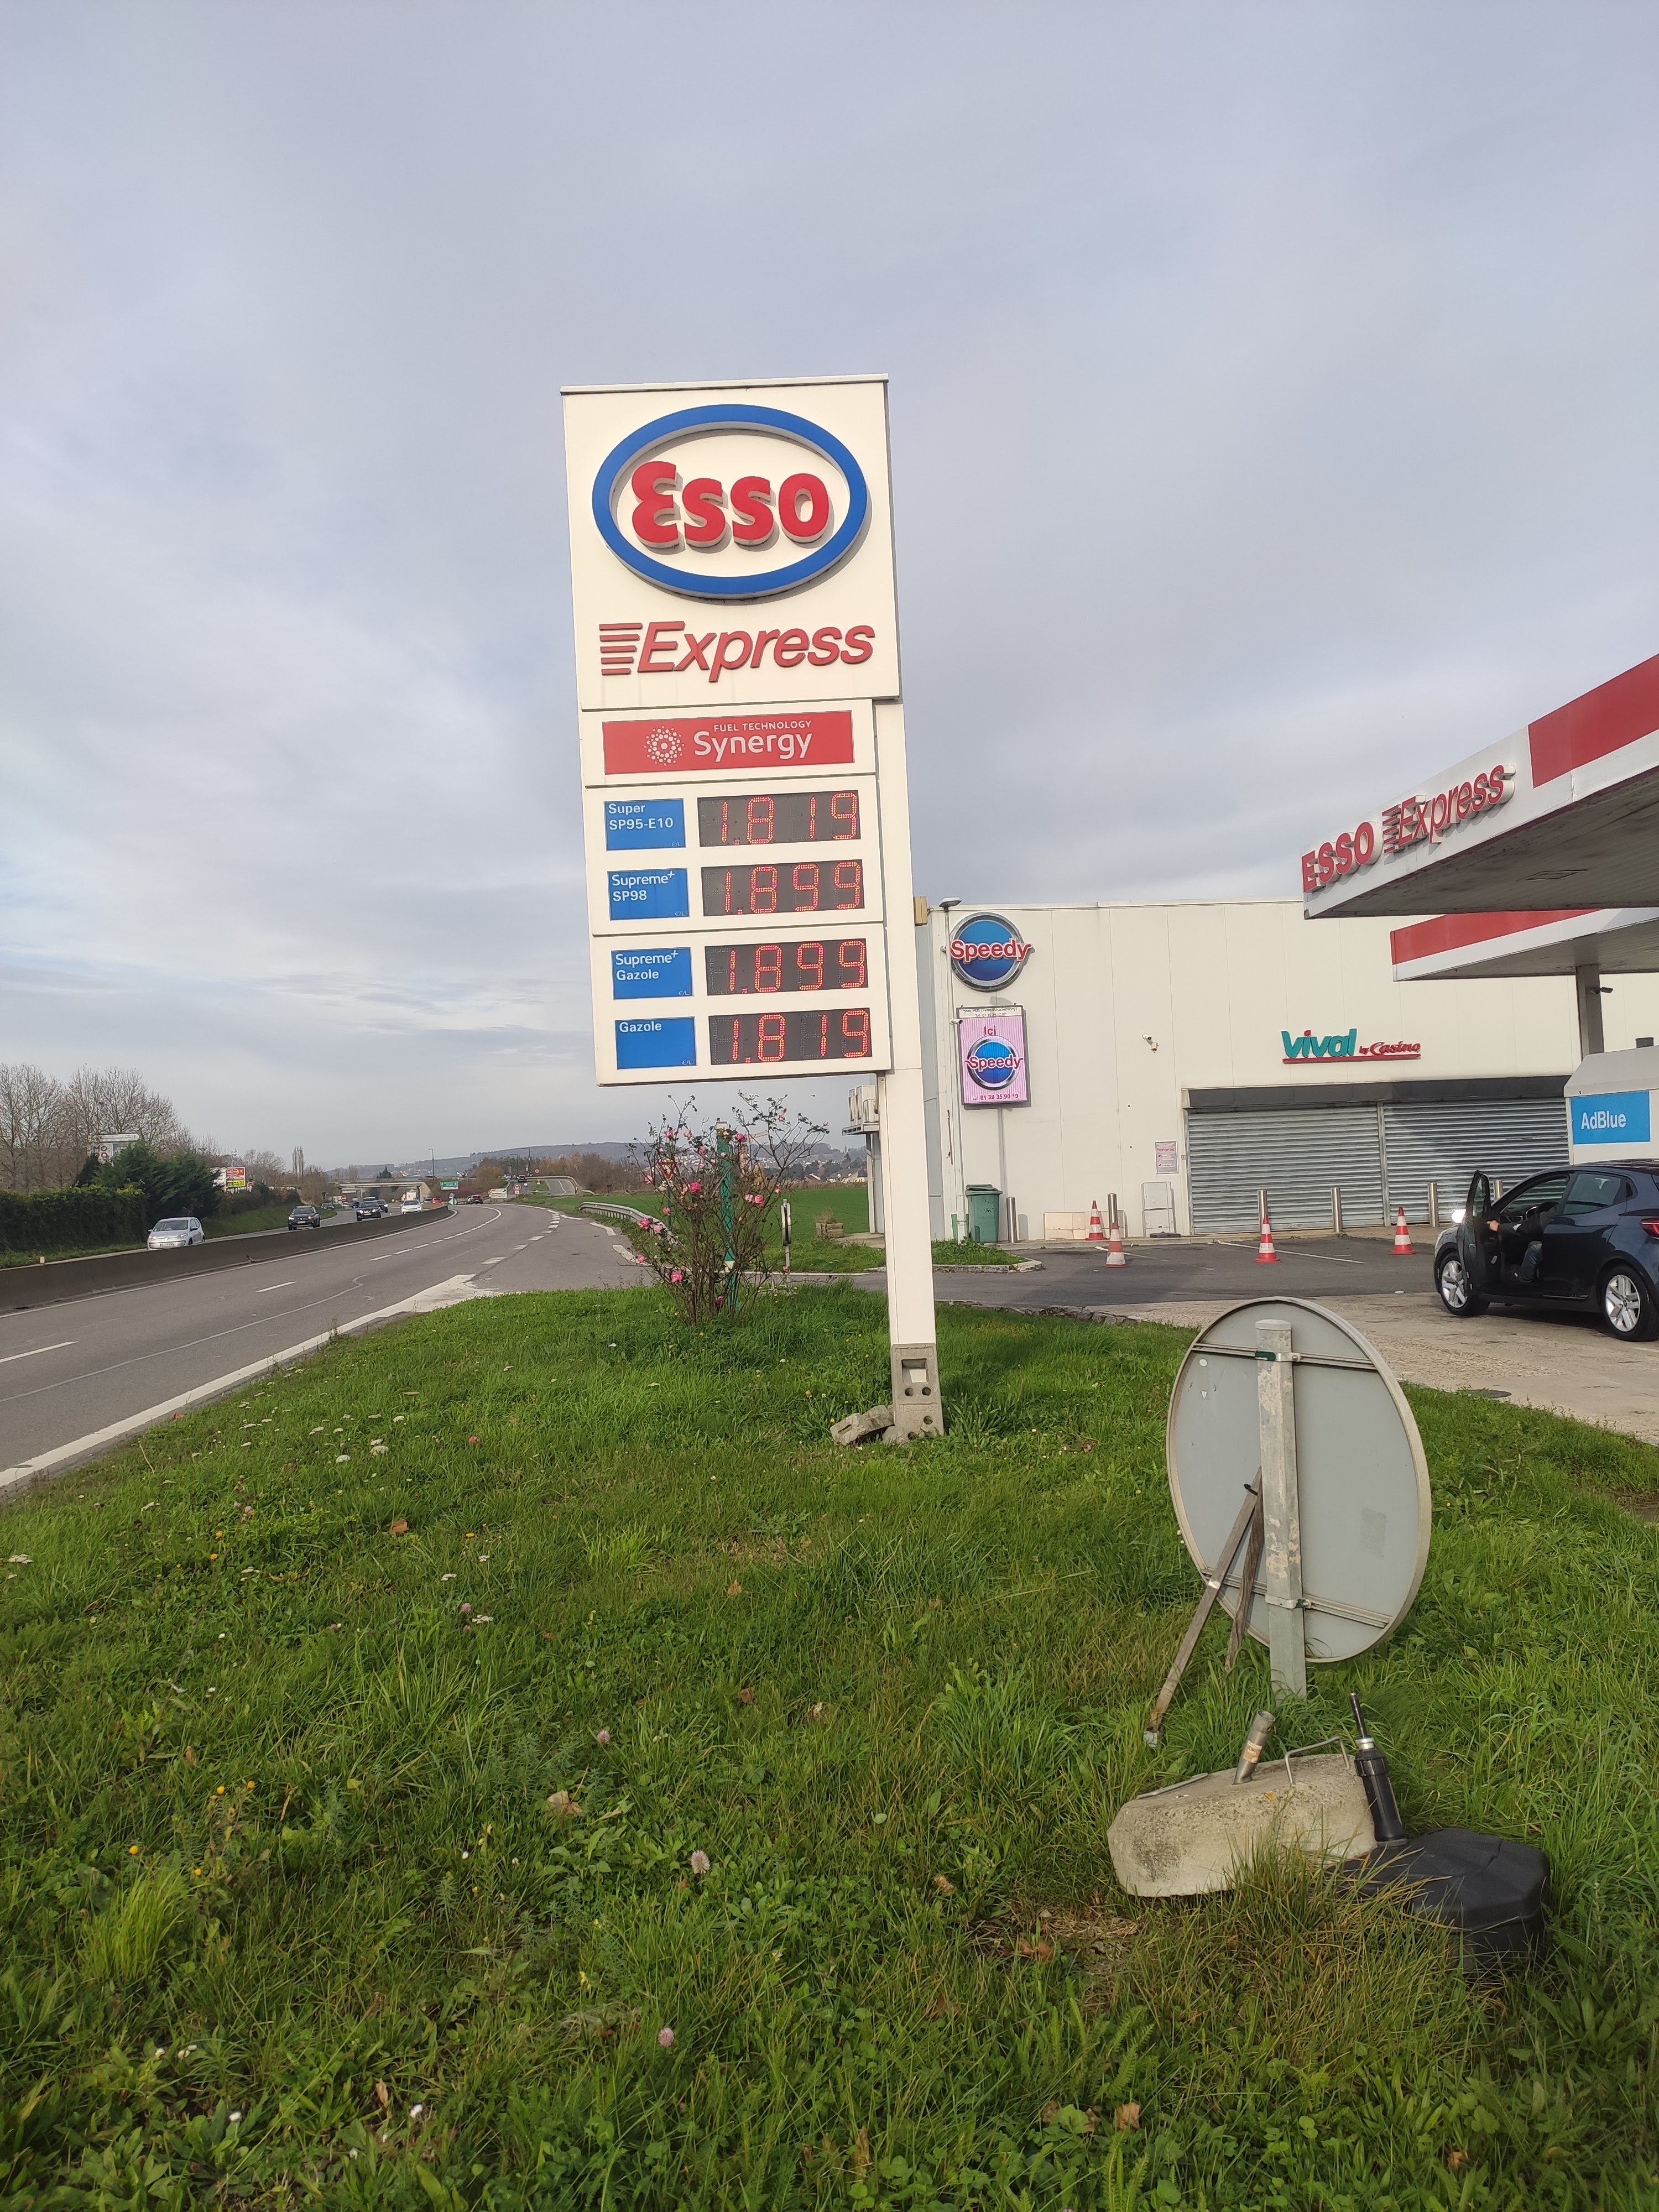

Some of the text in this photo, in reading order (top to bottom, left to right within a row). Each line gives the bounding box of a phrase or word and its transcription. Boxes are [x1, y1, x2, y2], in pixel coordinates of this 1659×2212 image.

[637, 620, 875, 684] Express
[713, 720, 812, 732] FUEL TECHNOLOGY
[693, 731, 813, 763] Synergy
[608, 804, 645, 816] Super
[1398, 764, 1512, 844] Express
[609, 817, 674, 830] SP95-E10
[613, 890, 647, 901] SP98
[950, 938, 1032, 963] Speedy
[616, 969, 659, 980] Gazole
[619, 1020, 662, 1032] Gazole
[984, 1025, 997, 1036] Ici
[1359, 1046, 1370, 1055] by
[1369, 1040, 1421, 1056] Casino
[964, 1054, 1024, 1071] Speedy
[1580, 1110, 1627, 1130] AdBlue
